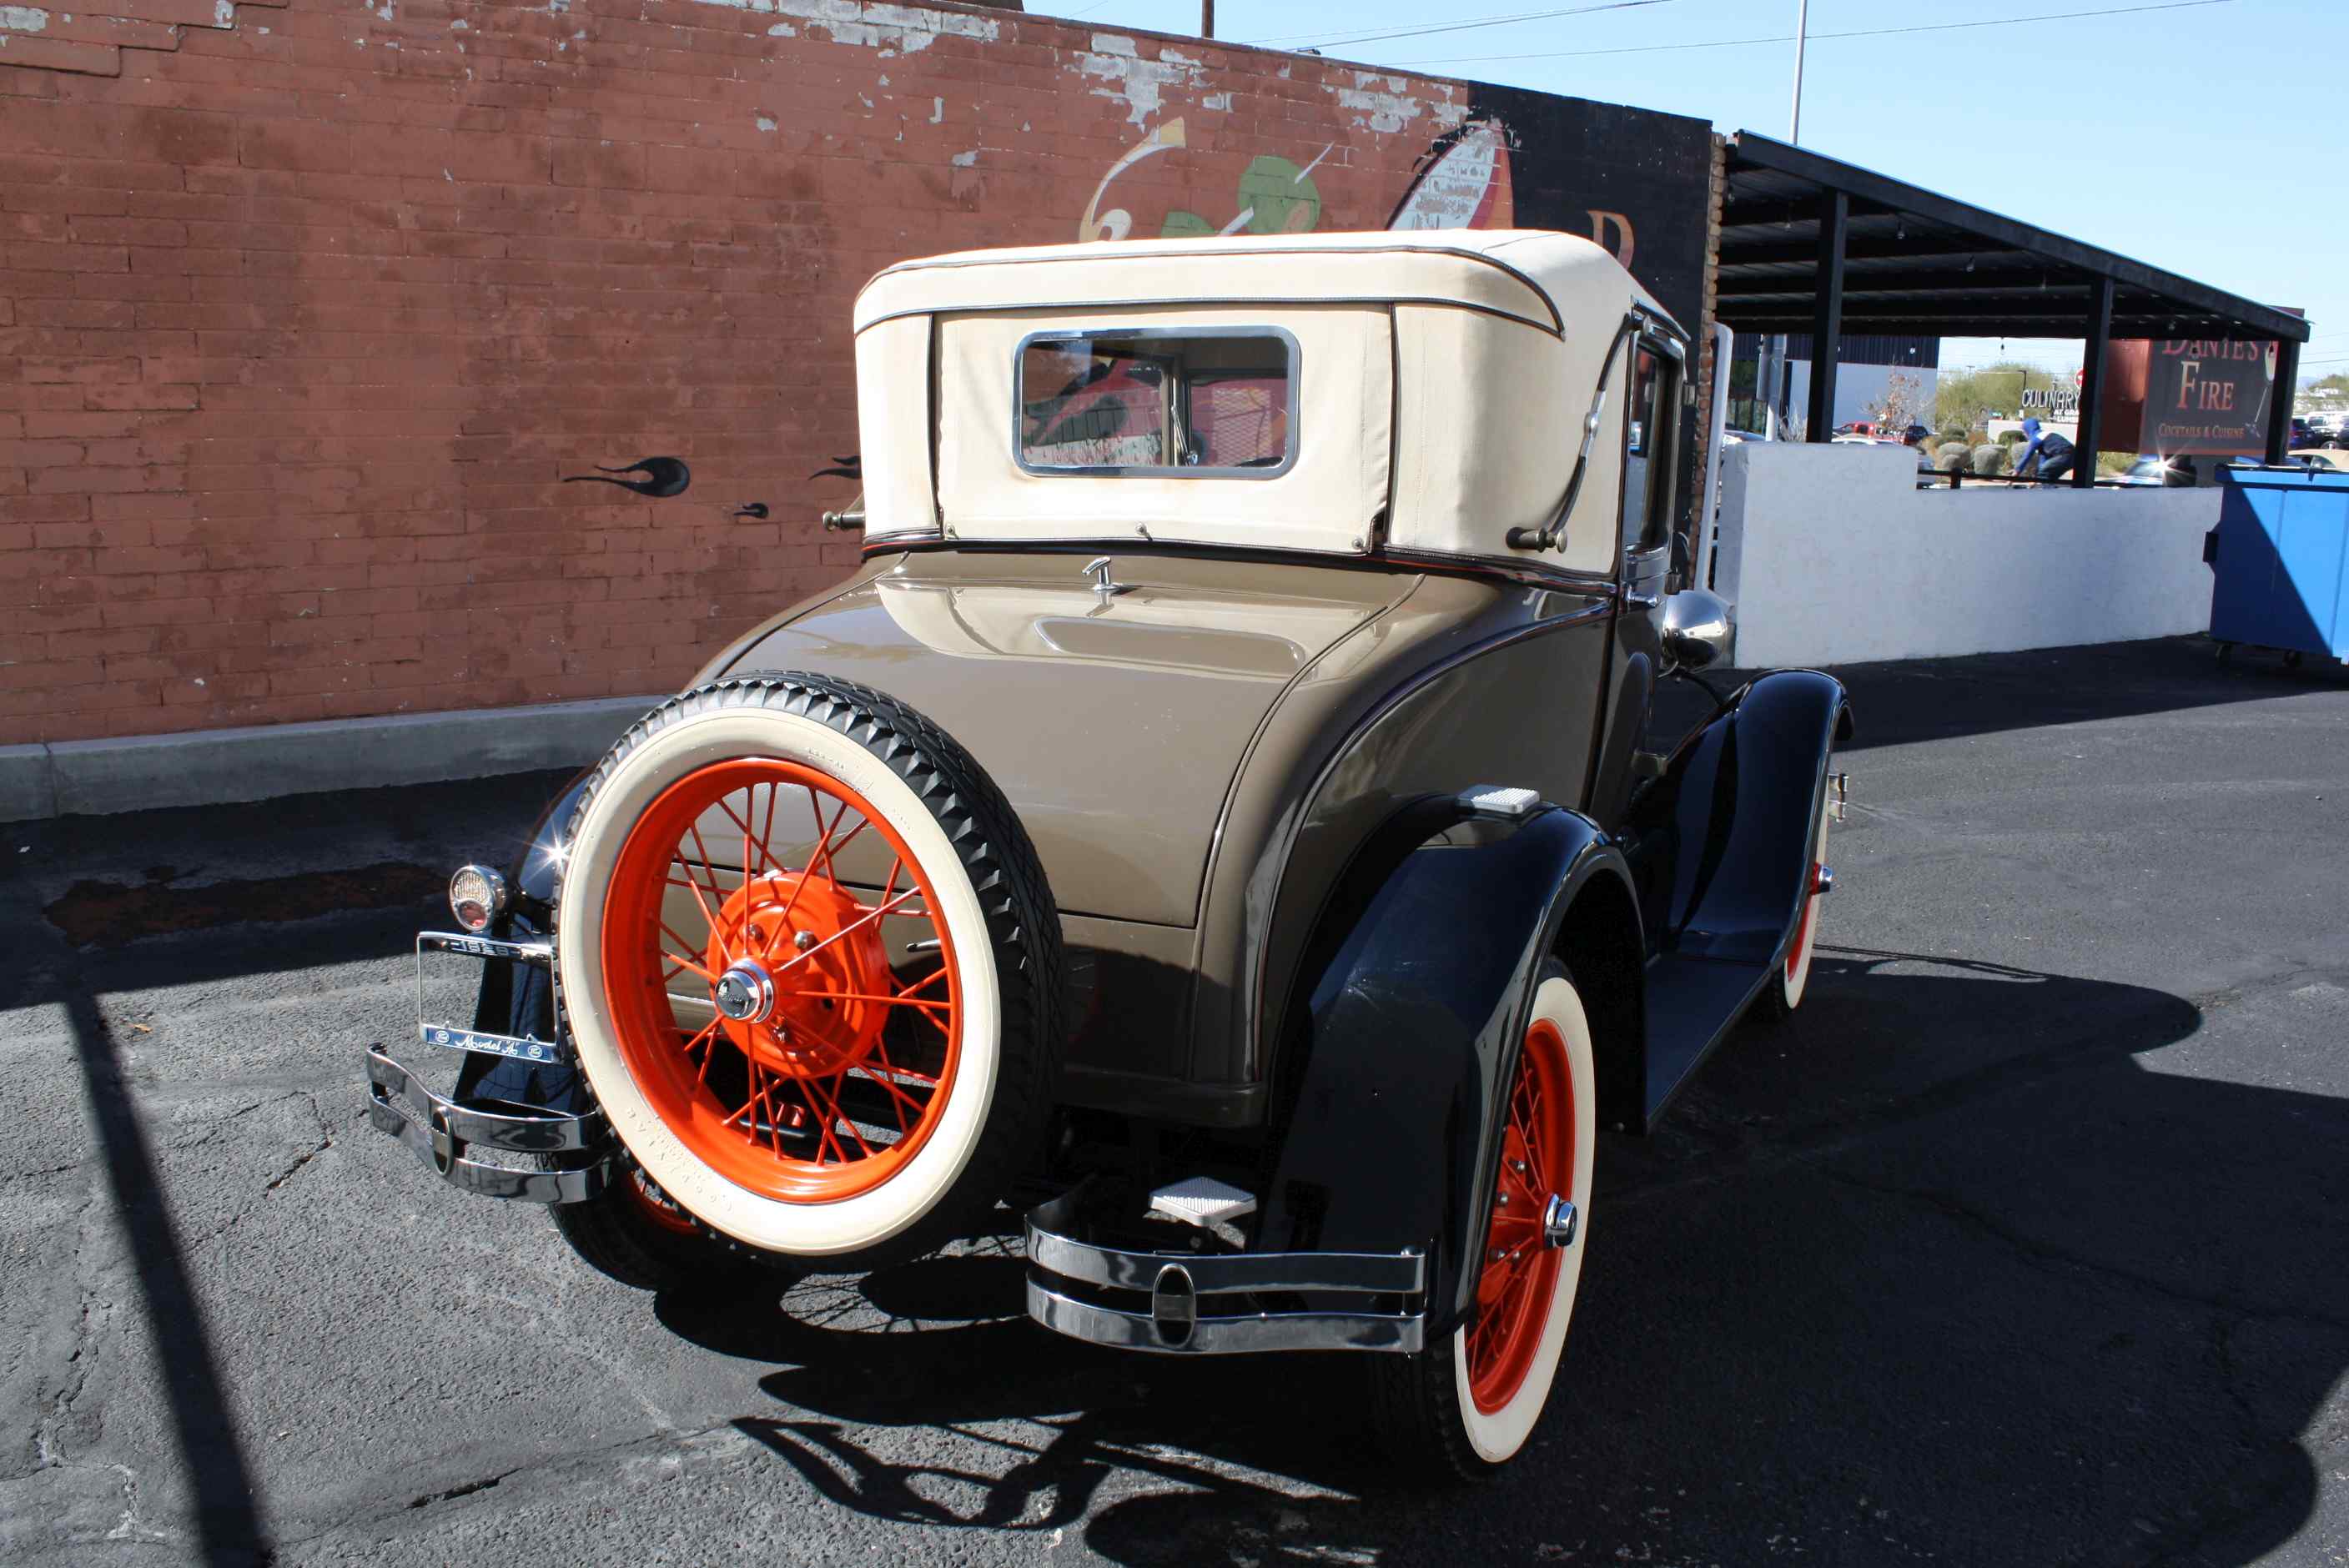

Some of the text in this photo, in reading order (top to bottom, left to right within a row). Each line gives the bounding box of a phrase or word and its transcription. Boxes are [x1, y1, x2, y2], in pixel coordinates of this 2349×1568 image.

[2176, 360, 2235, 410] FIRE
[2022, 389, 2081, 410] CULINARY
[455, 1034, 501, 1052] Model
